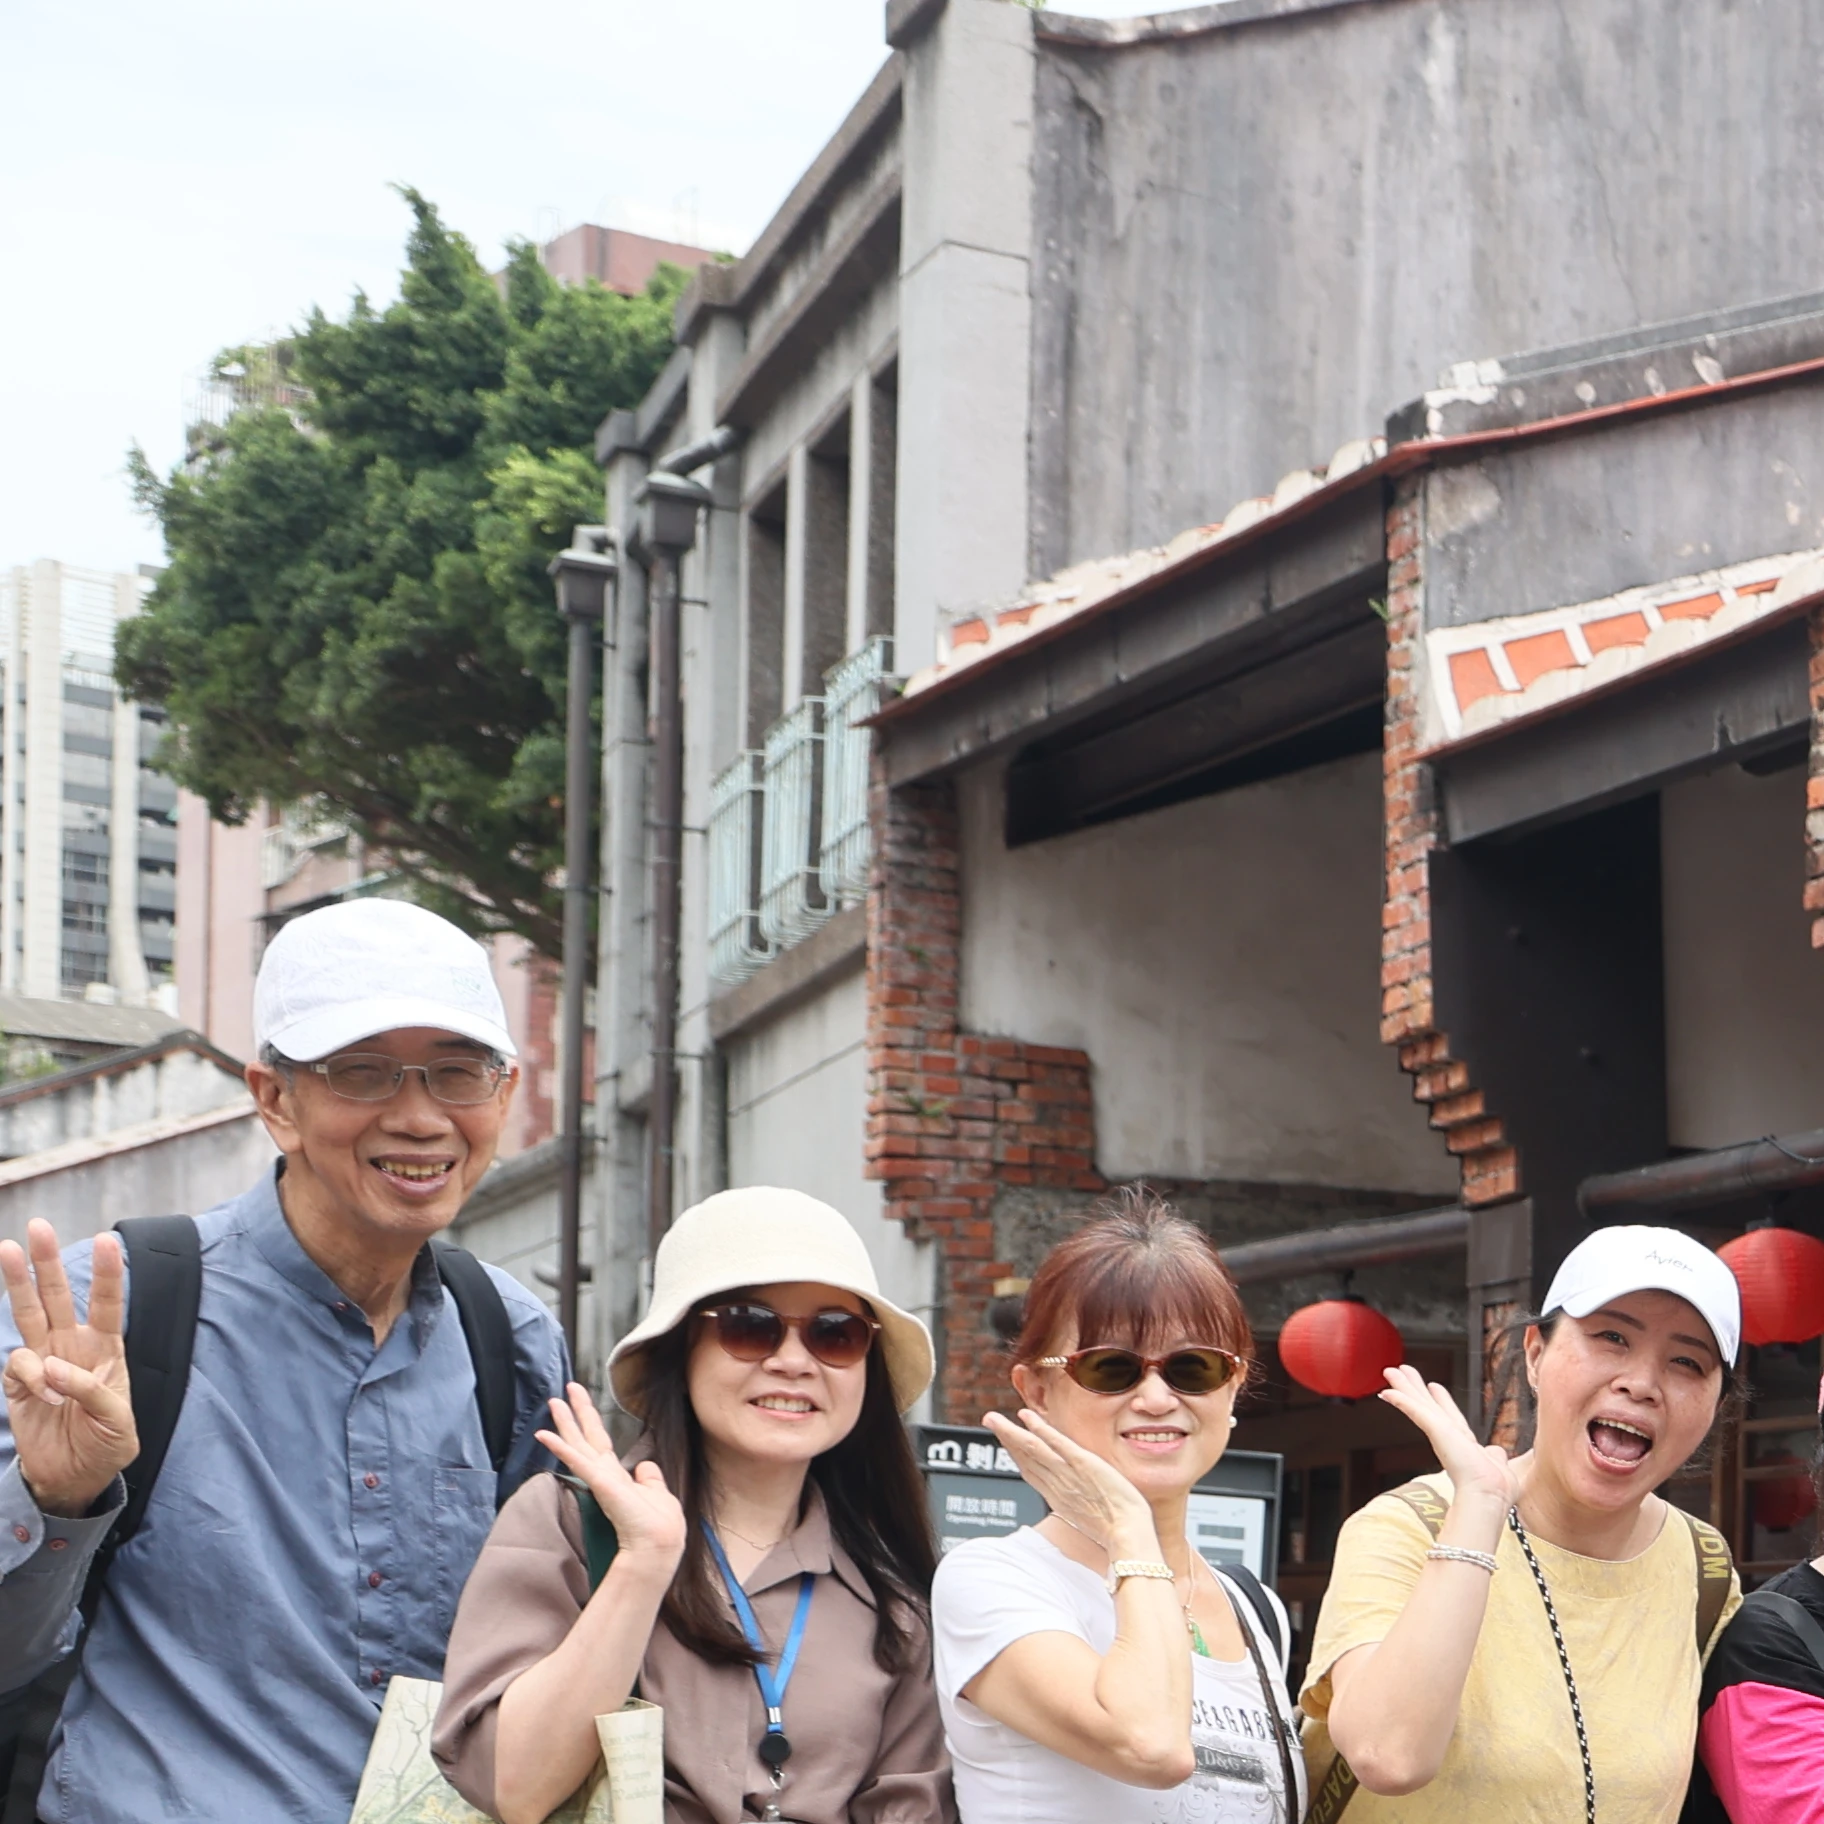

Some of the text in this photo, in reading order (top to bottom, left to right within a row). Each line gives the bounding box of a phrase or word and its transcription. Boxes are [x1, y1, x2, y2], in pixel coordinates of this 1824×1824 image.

[945, 1495, 1017, 1518] 開放時間
[945, 1513, 987, 1527] Opening
